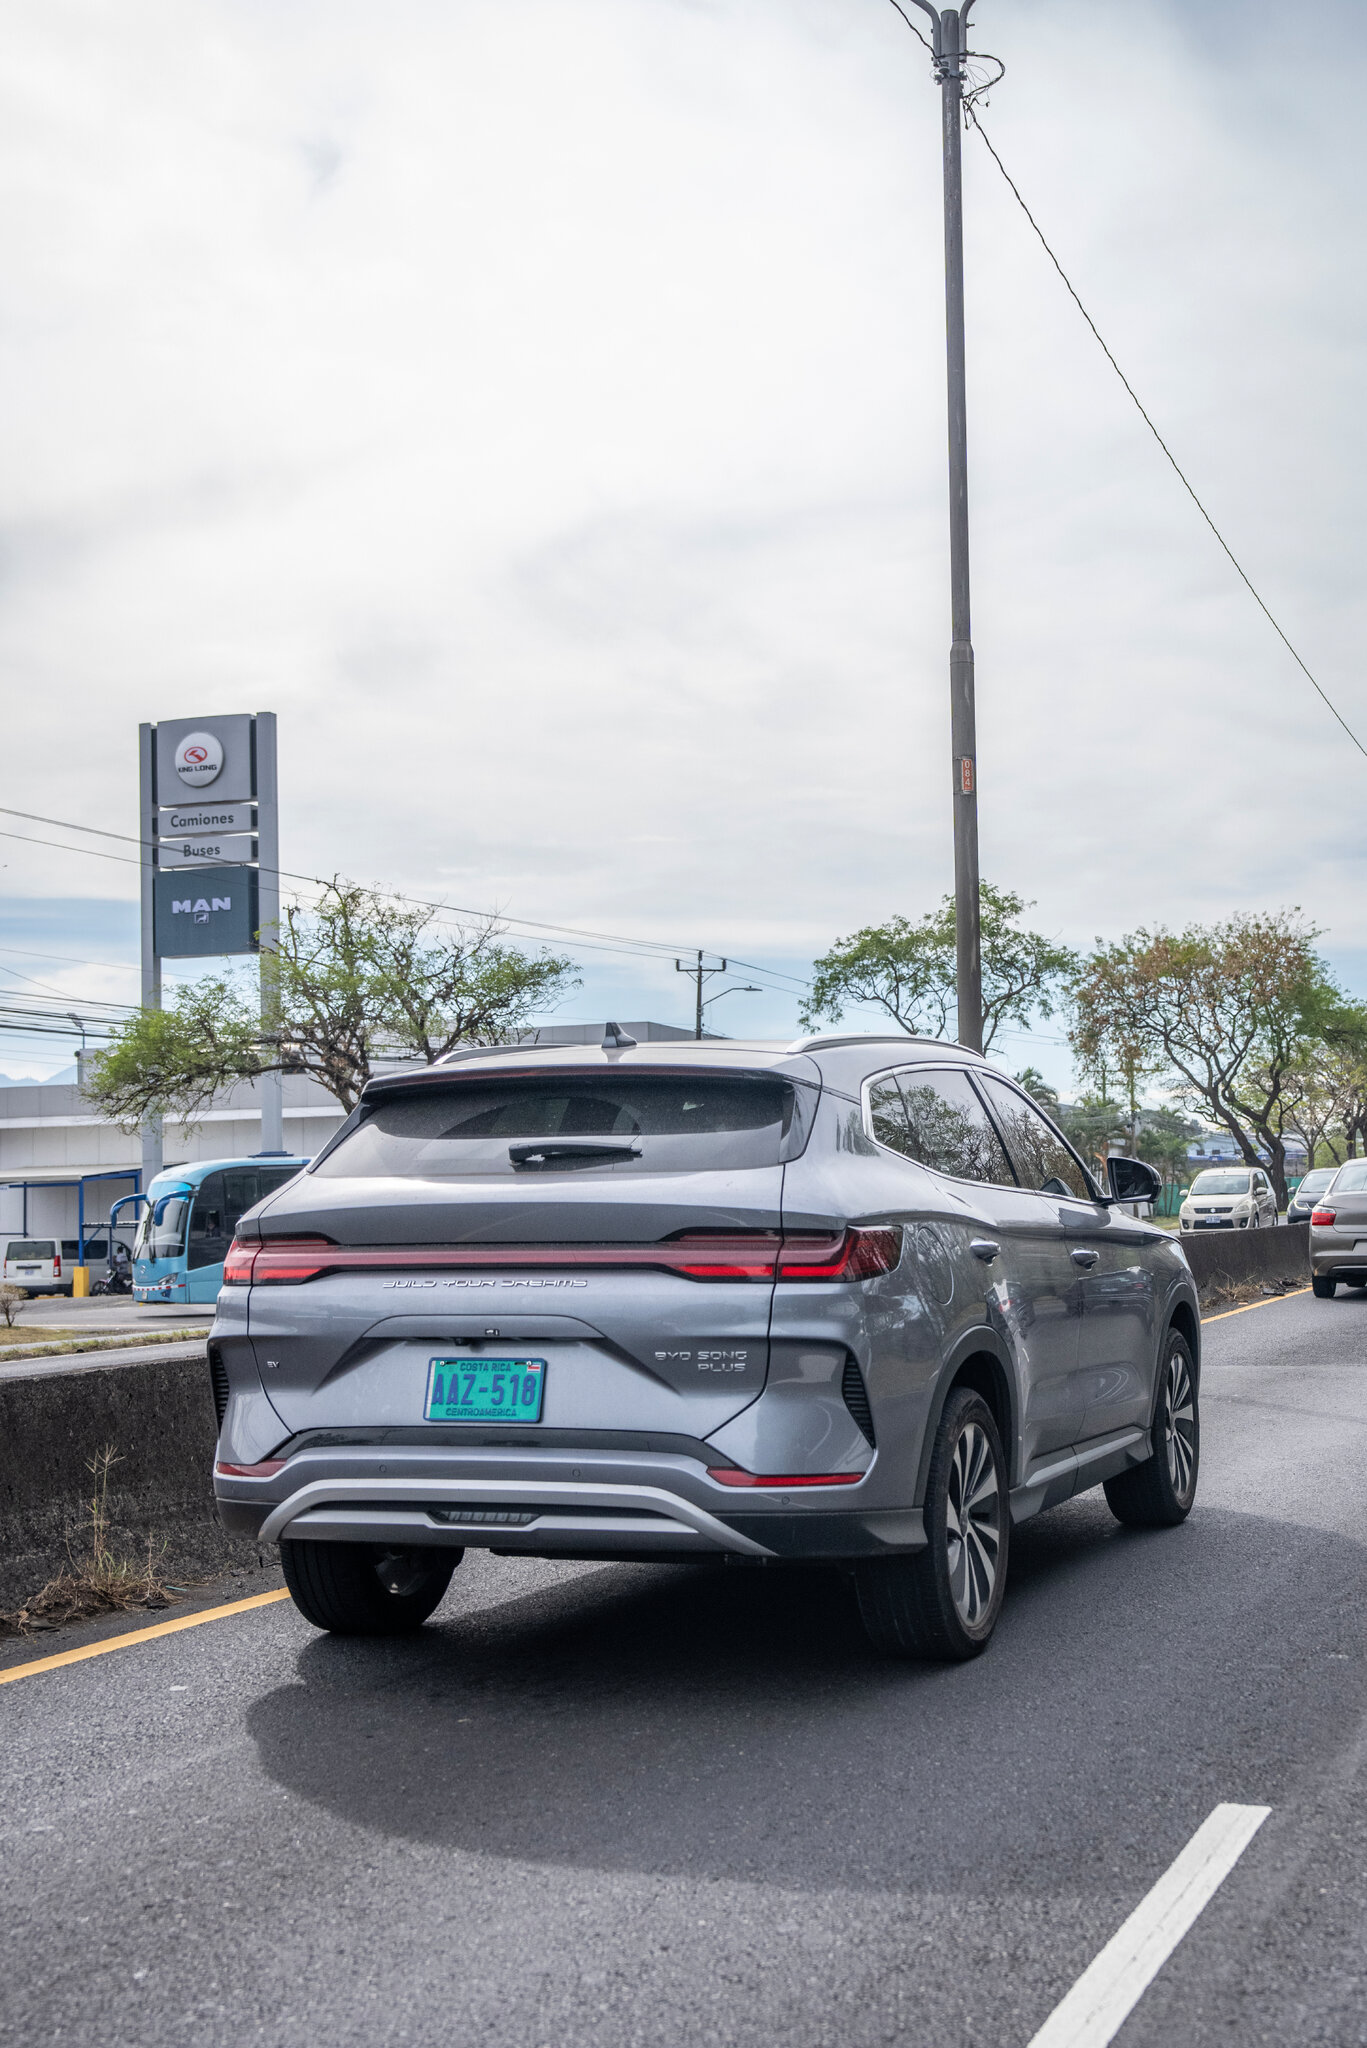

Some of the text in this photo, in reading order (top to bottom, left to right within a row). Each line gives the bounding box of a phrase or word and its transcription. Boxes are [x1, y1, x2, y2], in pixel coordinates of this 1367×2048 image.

[195, 764, 217, 772] LONG
[964, 760, 972, 787] 084
[170, 813, 234, 828] Camiones
[183, 845, 221, 858] Buses
[171, 897, 232, 914] MAN
[383, 1280, 588, 1288] BUILD YOUR DREAMS
[655, 1351, 747, 1360] BYD SONG
[460, 1362, 511, 1371] COSTA RICA
[698, 1363, 746, 1372] PLUS
[431, 1373, 537, 1406] AAZ-518
[445, 1407, 517, 1417] CENTROAMERICA
